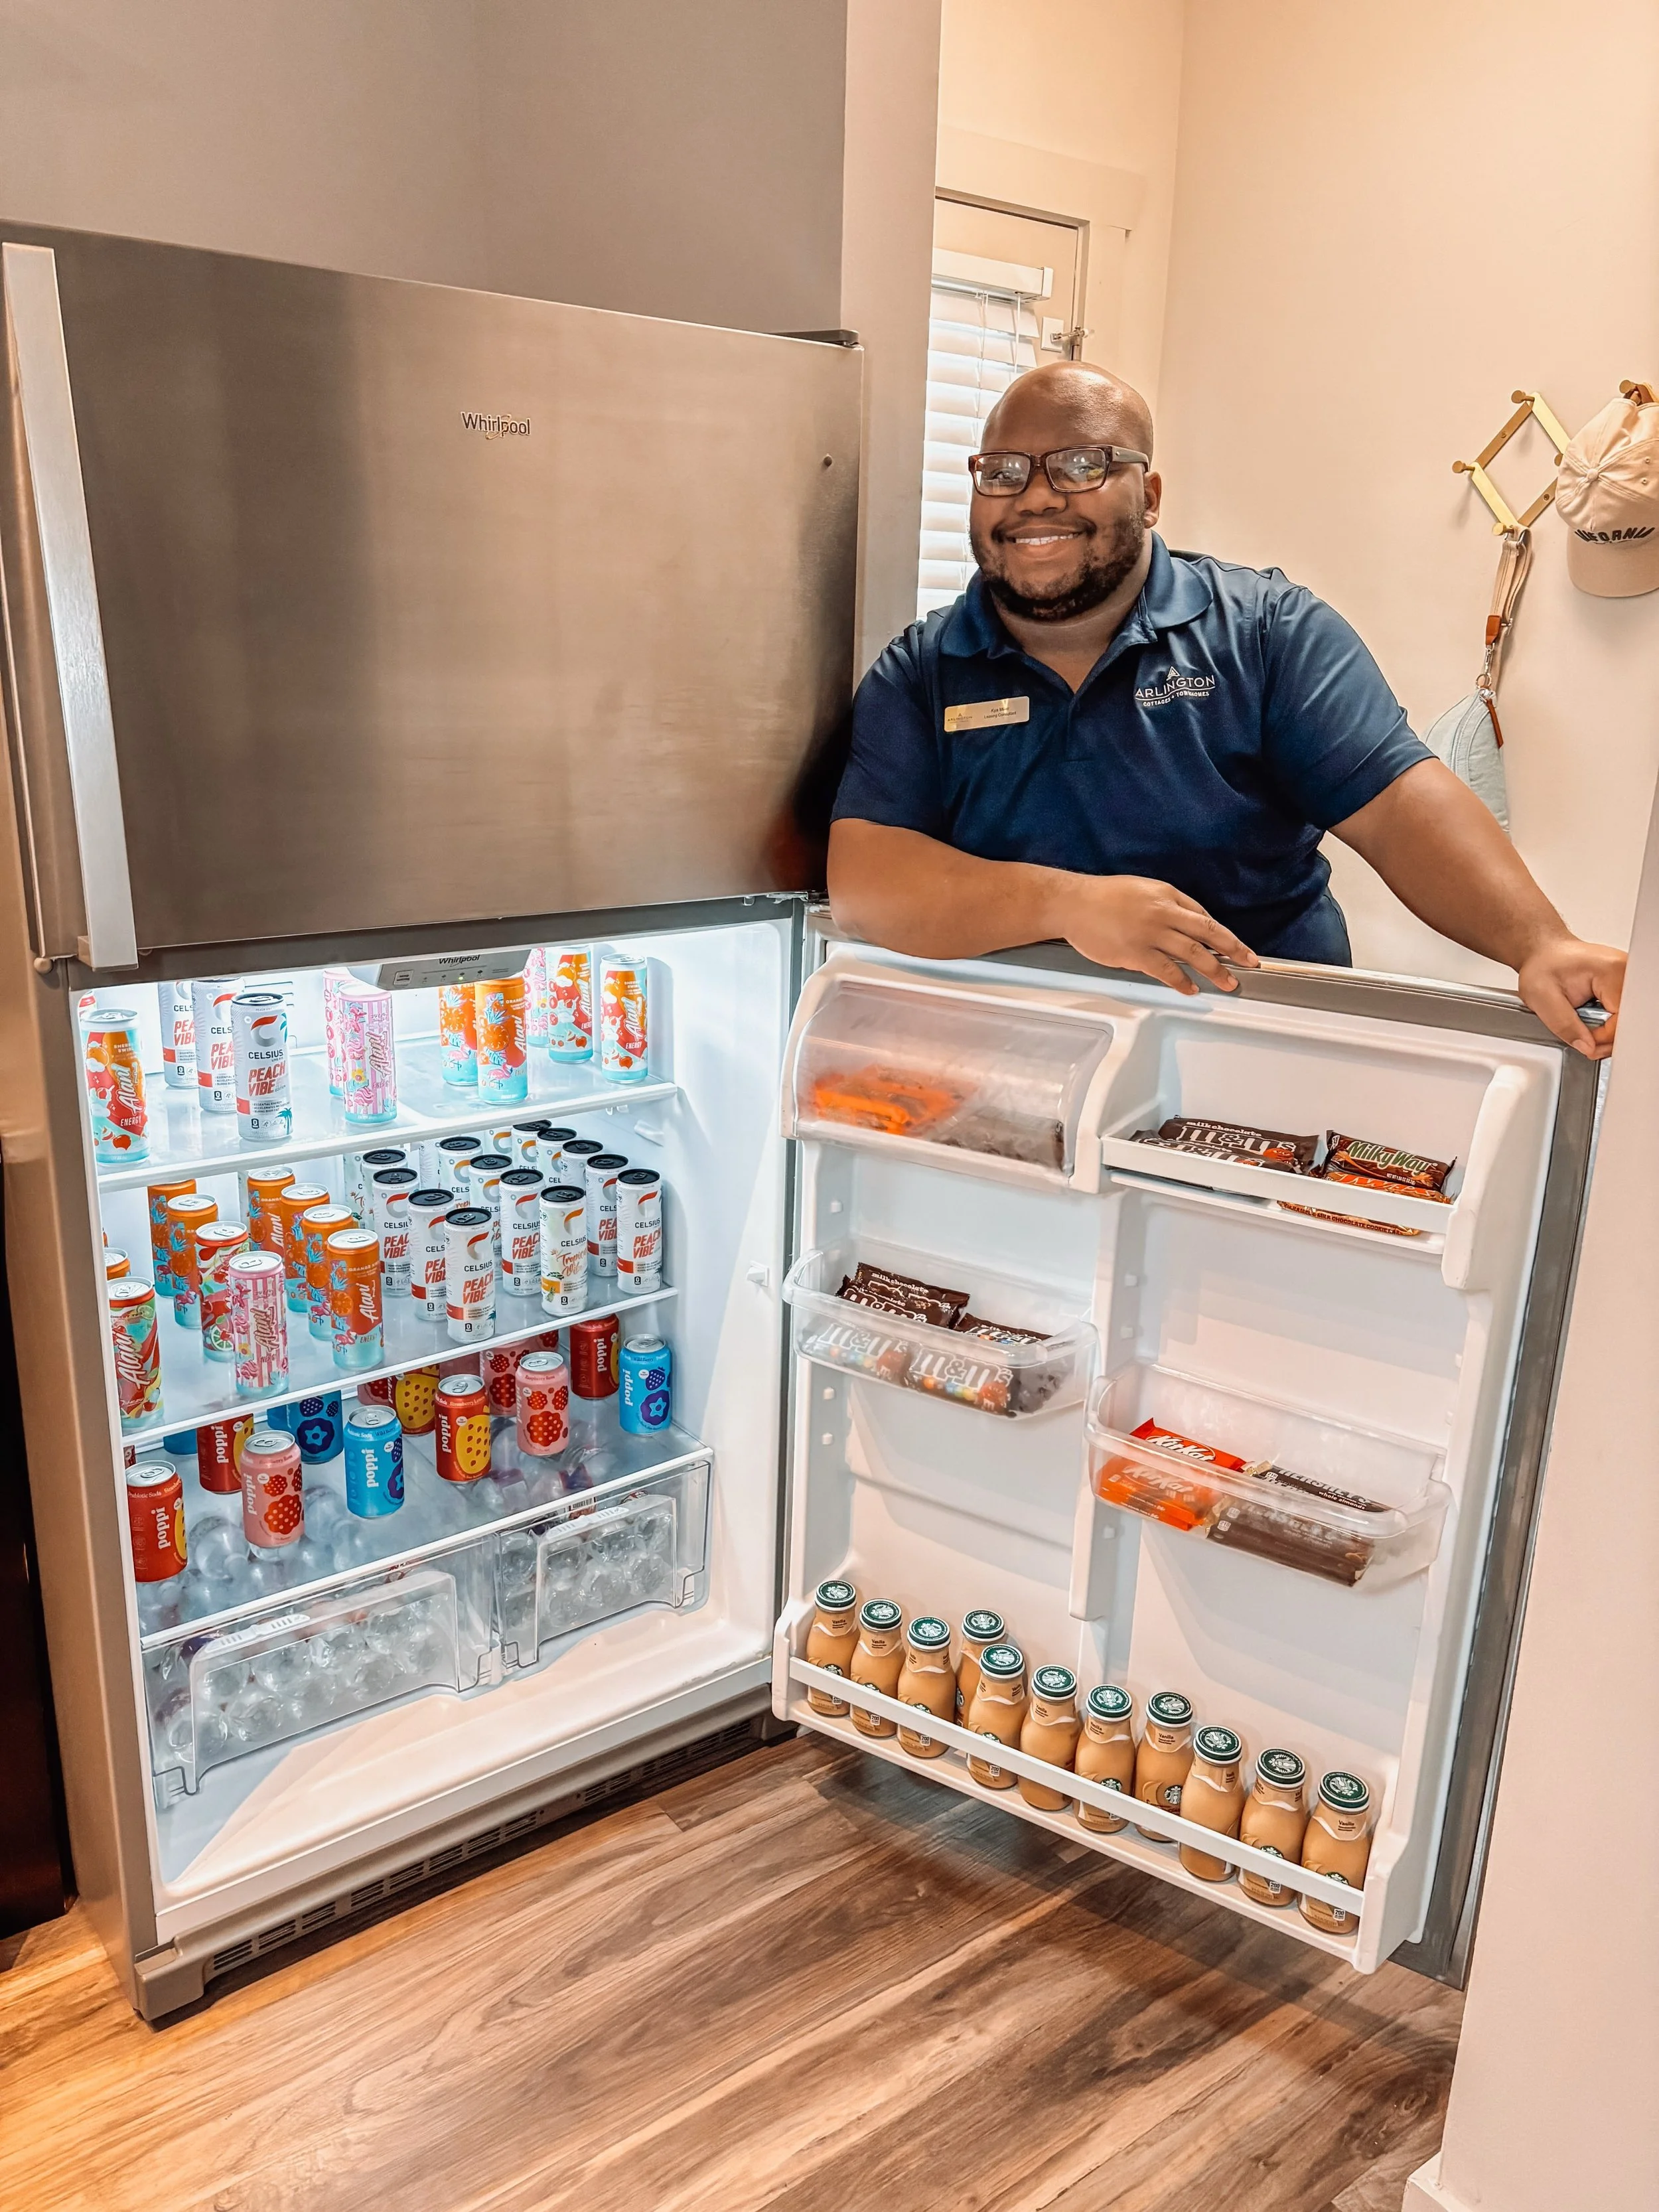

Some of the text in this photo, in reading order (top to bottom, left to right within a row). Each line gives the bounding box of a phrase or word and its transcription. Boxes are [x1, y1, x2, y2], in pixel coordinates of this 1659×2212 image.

[461, 411, 531, 439] Whirlpool
[1135, 674, 1216, 698] ARLINGTON
[1143, 698, 1171, 707] COTTAGES
[439, 954, 480, 966] Whirlpool
[174, 1019, 195, 1033] PEA
[174, 1032, 195, 1047] VIB
[511, 1015, 526, 1057] Alani
[210, 1041, 234, 1057] PEA
[248, 1049, 283, 1059] CELSIUS
[249, 1061, 286, 1082] PEACH
[248, 1079, 276, 1097] VIBE
[120, 1116, 142, 1127] ENERGY
[1186, 1120, 1262, 1137] milk chocolate
[1346, 1140, 1431, 1176] Milky Way
[267, 1213, 284, 1248] Alani
[599, 1217, 617, 1230] PEA
[635, 1218, 661, 1228] CELSIUS
[1331, 1216, 1366, 1228] CHOCOLATE
[1366, 1224, 1388, 1233] COOKIE
[384, 1232, 409, 1248] PEAC
[561, 1236, 587, 1247] CELSIUS
[633, 1228, 662, 1248] PEACH
[384, 1245, 407, 1260] VIBE
[512, 1245, 536, 1260] VIBE
[633, 1242, 655, 1259] VIBE
[425, 1257, 446, 1273] PEA
[464, 1260, 493, 1272] CELSIUS
[463, 1269, 494, 1293] PEACH
[871, 1272, 929, 1293] milk chocolate
[355, 1283, 379, 1324] Alani
[463, 1288, 486, 1305] VIBE
[115, 1332, 151, 1390] Alani
[593, 1338, 607, 1372] poppi
[622, 1368, 634, 1407] poppi
[439, 1414, 452, 1453] poppi
[211, 1425, 229, 1464] poppi
[361, 1447, 380, 1488] poppi
[244, 1473, 257, 1516] poppi
[1318, 1490, 1337, 1501] whole
[1338, 1497, 1365, 1511] almonds
[151, 1507, 171, 1550] poppi
[1035, 1704, 1048, 1714] Vanilla
